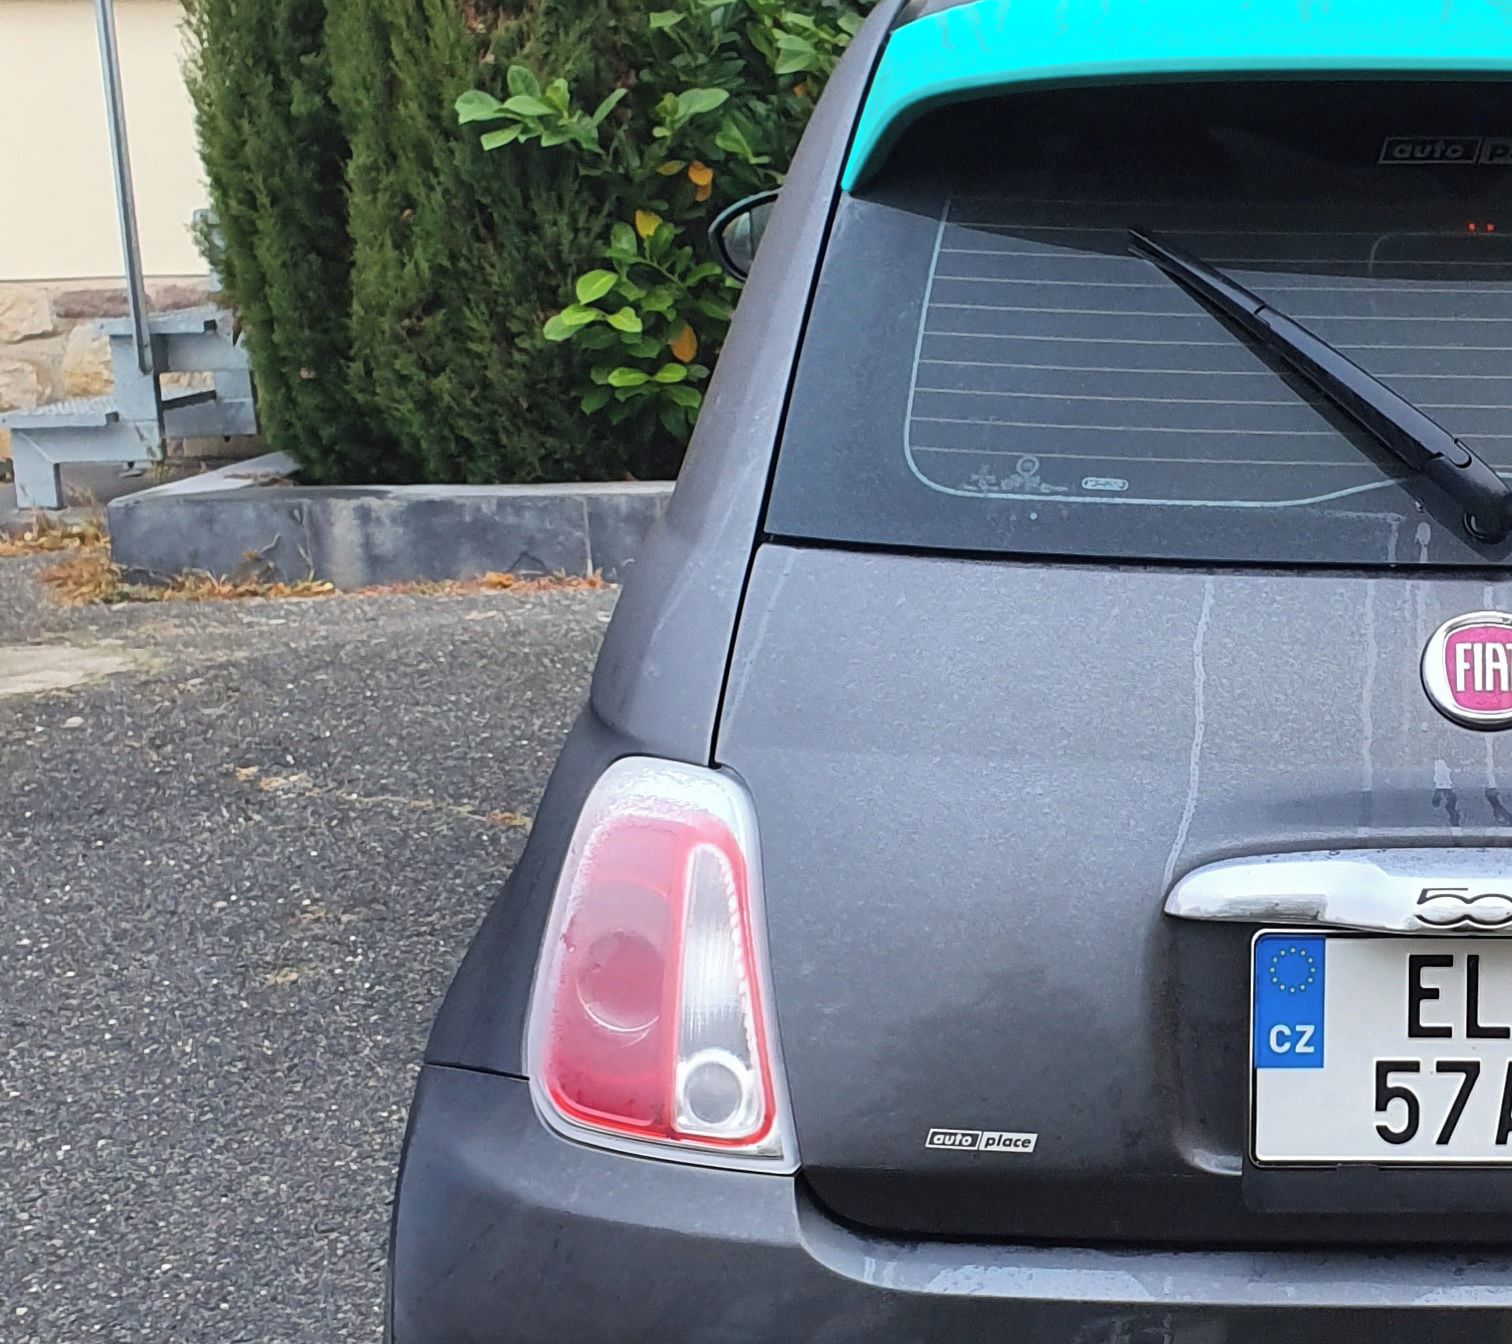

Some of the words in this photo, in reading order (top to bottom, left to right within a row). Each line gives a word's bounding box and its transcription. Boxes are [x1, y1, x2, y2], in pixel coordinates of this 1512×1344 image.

[1391, 139, 1465, 159] auto
[1269, 1024, 1315, 1054] CZ
[933, 1134, 972, 1146] auto
[984, 1134, 1031, 1148] place
